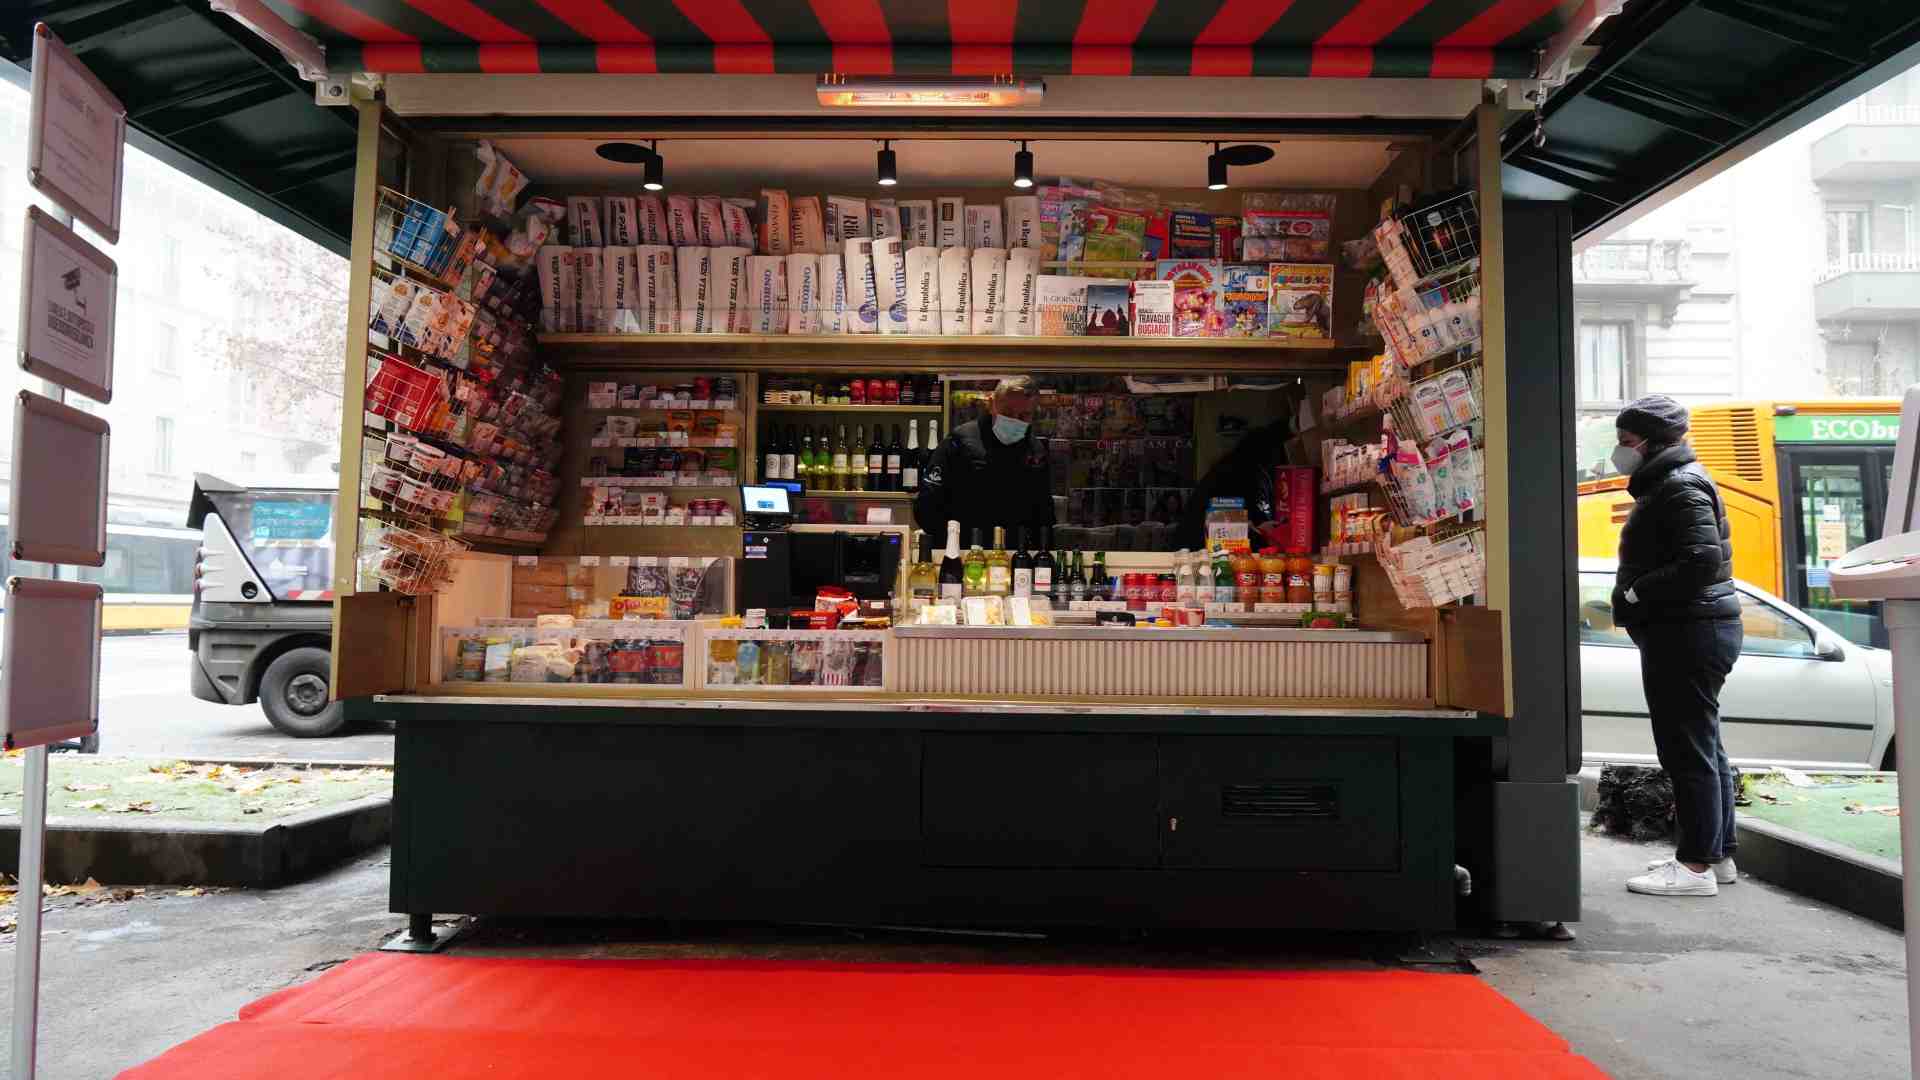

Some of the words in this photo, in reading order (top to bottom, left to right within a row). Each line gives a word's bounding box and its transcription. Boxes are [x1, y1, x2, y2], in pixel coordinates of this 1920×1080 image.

[762, 269, 772, 314] GIORNO
[800, 266, 811, 314] GIORNO
[834, 268, 843, 315] GIORNO
[919, 271, 930, 313] Repubblica
[956, 272, 968, 313] Repubblica
[984, 273, 998, 314] Repubblica
[1019, 273, 1032, 315] Repubblica
[761, 319, 769, 331] IL
[799, 316, 806, 330] IL
[833, 318, 840, 331] IL
[1138, 314, 1171, 324] TRAVAGLIO
